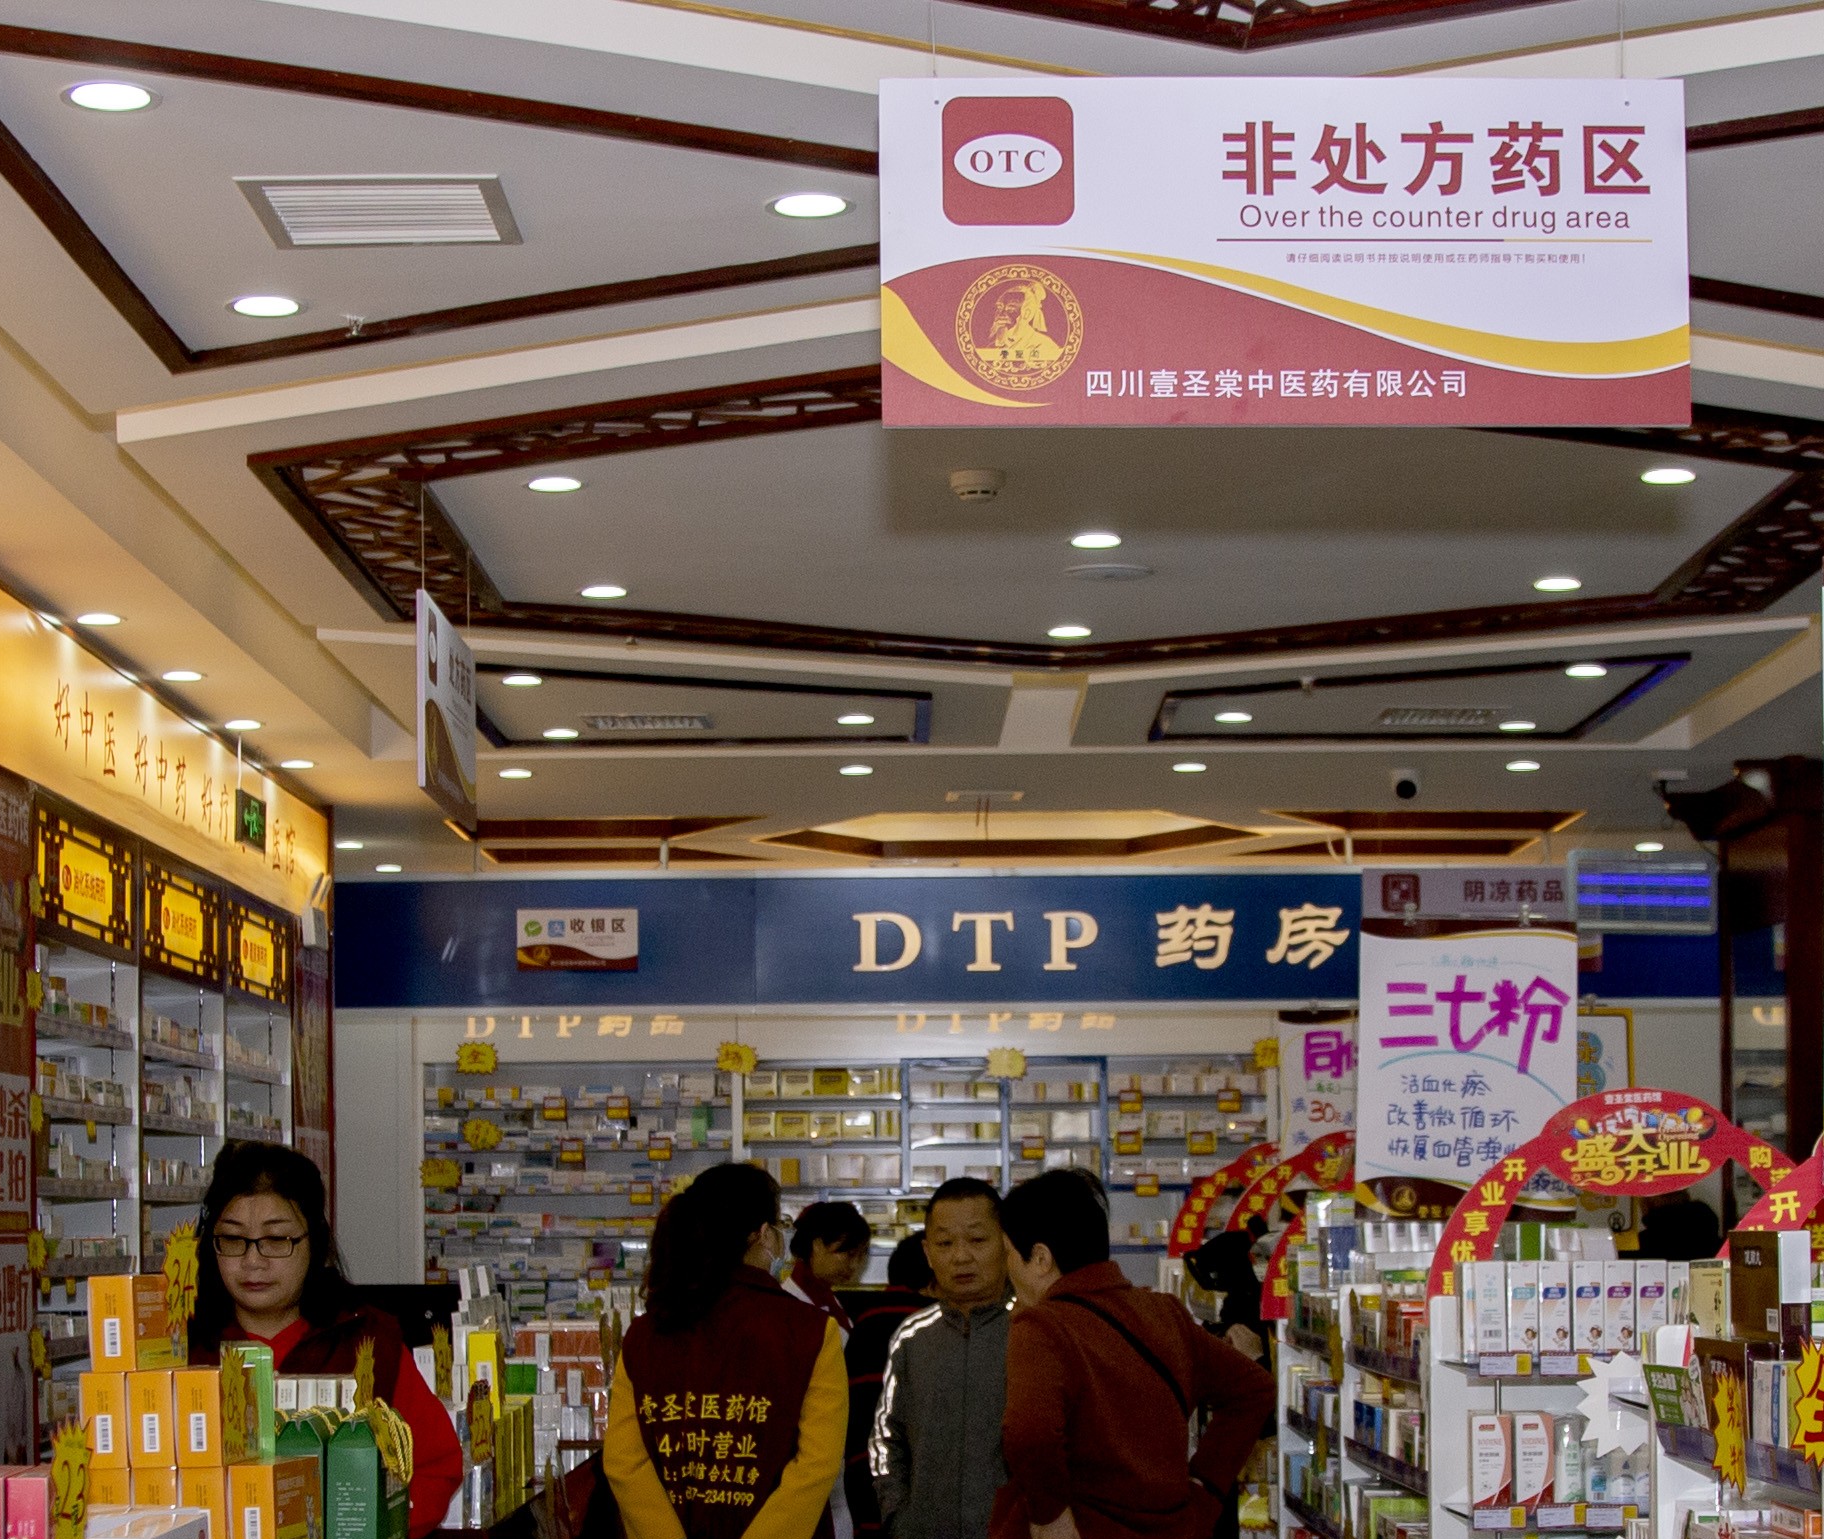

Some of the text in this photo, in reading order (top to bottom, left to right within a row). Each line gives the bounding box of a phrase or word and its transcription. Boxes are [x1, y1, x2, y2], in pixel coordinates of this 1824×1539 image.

[969, 149, 1046, 174] OTC
[1221, 120, 1651, 197] 非处方药区
[1239, 205, 1631, 235] Over the counter drug area
[1085, 369, 1468, 399] 四川壹圣棠中医药有限公司
[1463, 878, 1566, 904] 阴凉药品
[569, 917, 627, 935] 收银区
[851, 902, 1352, 974] DTP 药房
[1379, 974, 1571, 1073] 三七粉
[1401, 1069, 1493, 1097] 活血化瘀
[1386, 1099, 1520, 1133] 改善微循环
[1561, 1123, 1711, 1187] 盛大开业
[658, 1429, 758, 1460] 4时营业
